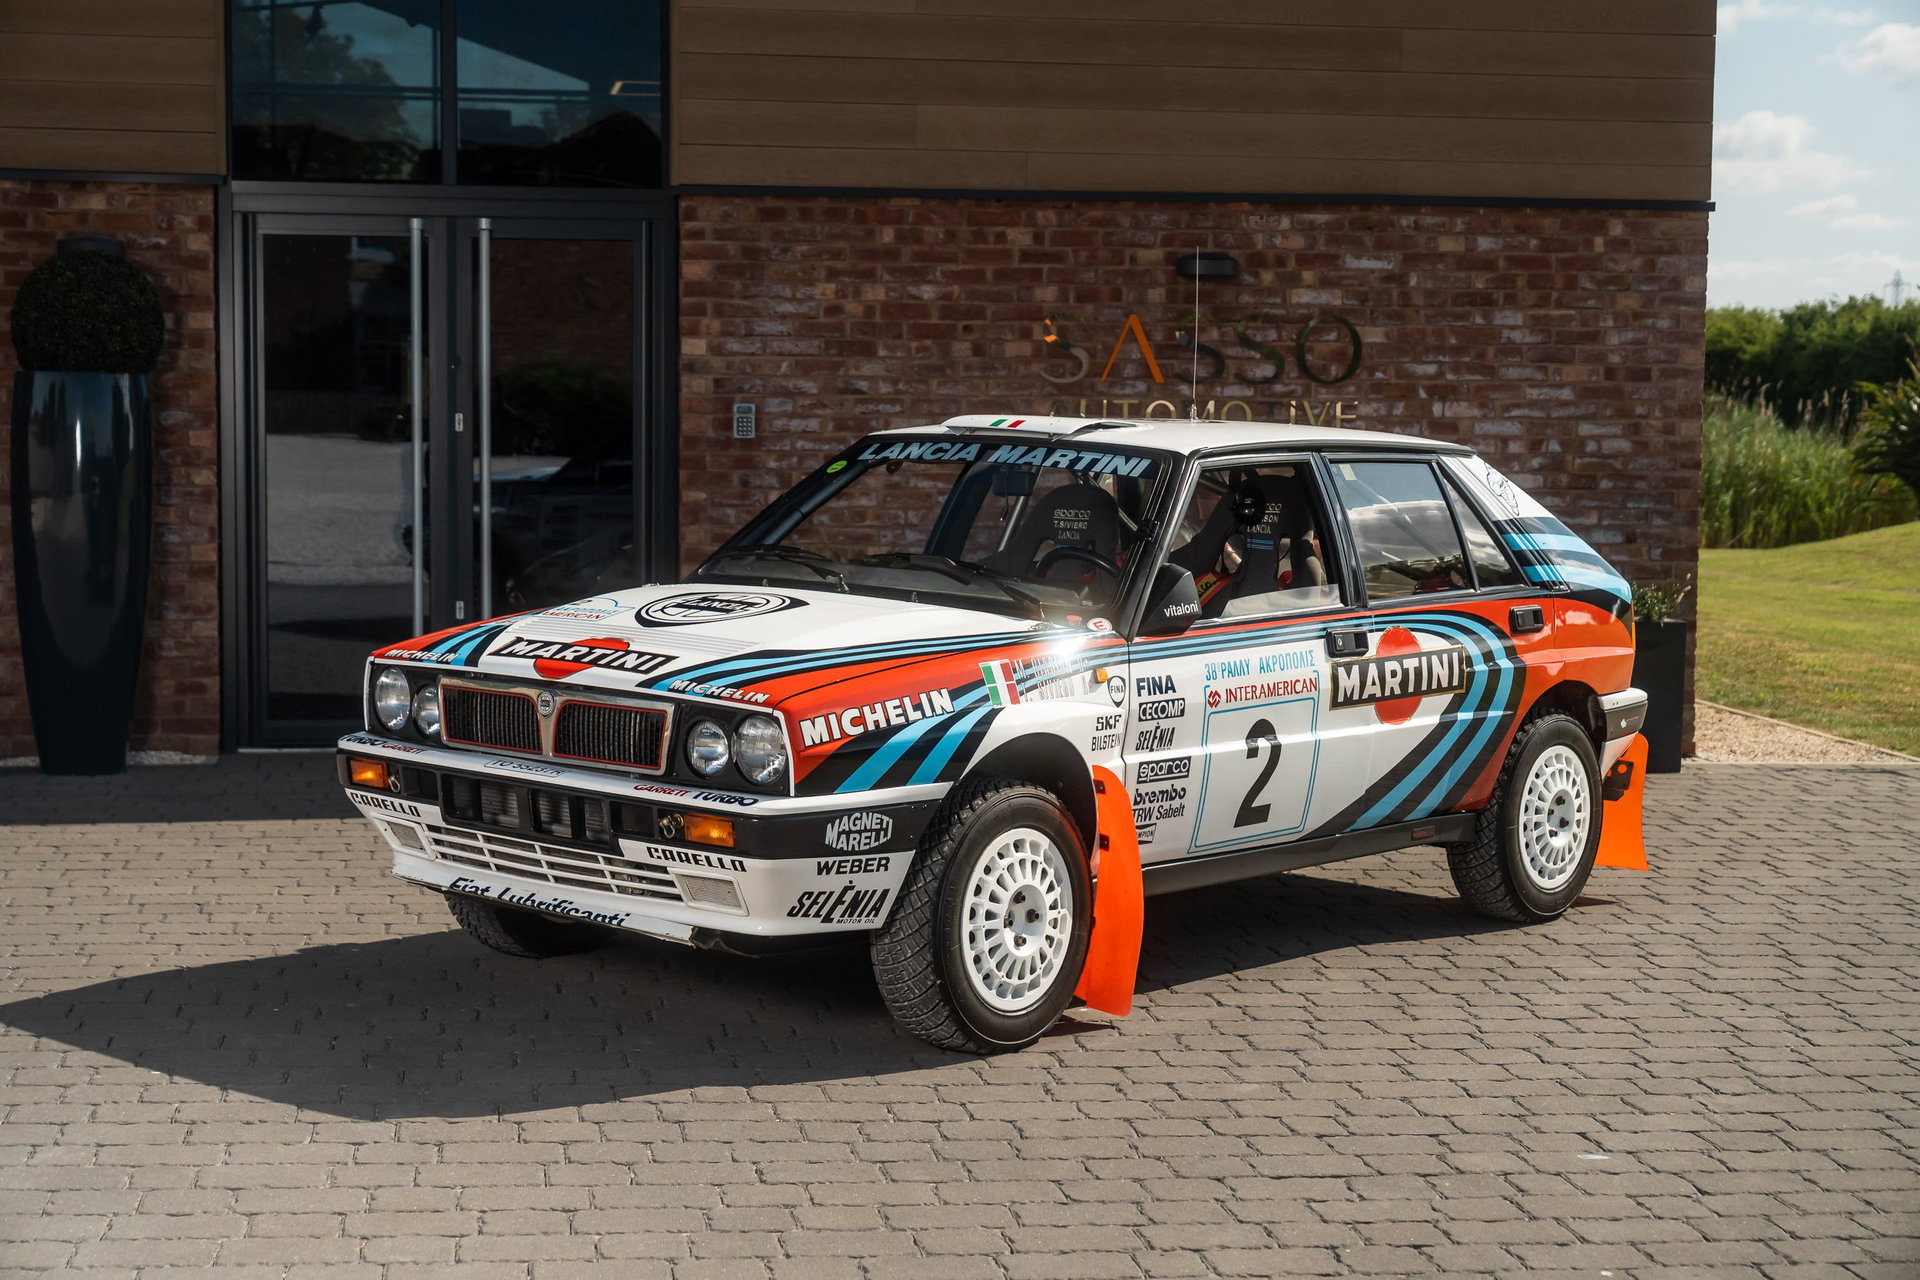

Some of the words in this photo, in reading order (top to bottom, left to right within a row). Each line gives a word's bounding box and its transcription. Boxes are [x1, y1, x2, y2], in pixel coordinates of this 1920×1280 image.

[1040, 313, 1362, 385] SASSO
[857, 441, 982, 461] LANCIA
[987, 445, 1152, 478] MARTINI
[1164, 601, 1199, 618] vitaloni
[1093, 621, 1107, 631] E
[383, 649, 460, 663] MICHELIN
[500, 640, 667, 674] MARTINI
[1136, 675, 1177, 697] FINA
[1337, 651, 1460, 703] MARTINI
[668, 679, 771, 704] MICHELIN
[1110, 684, 1124, 694] FINA
[1225, 677, 1318, 704] INTERAMERICAN
[799, 687, 956, 748] MICHELIN
[1139, 701, 1185, 721] CECOMP
[1095, 714, 1122, 732] SKF
[340, 735, 386, 746] TURBO
[1091, 733, 1121, 751] BILSTEIN
[1139, 759, 1190, 782] sparco
[1233, 718, 1282, 829] 2
[350, 791, 421, 818] CARELLO
[633, 783, 691, 797] GARRETT
[692, 791, 760, 807] TURBO
[1133, 784, 1187, 806] brembo
[1132, 806, 1155, 823] TRW
[1156, 802, 1185, 821] Sabelt
[646, 846, 748, 873] CARELLO
[816, 856, 890, 876] WEBER
[449, 876, 492, 896] Fiat
[497, 887, 632, 927] Lubrificanti
